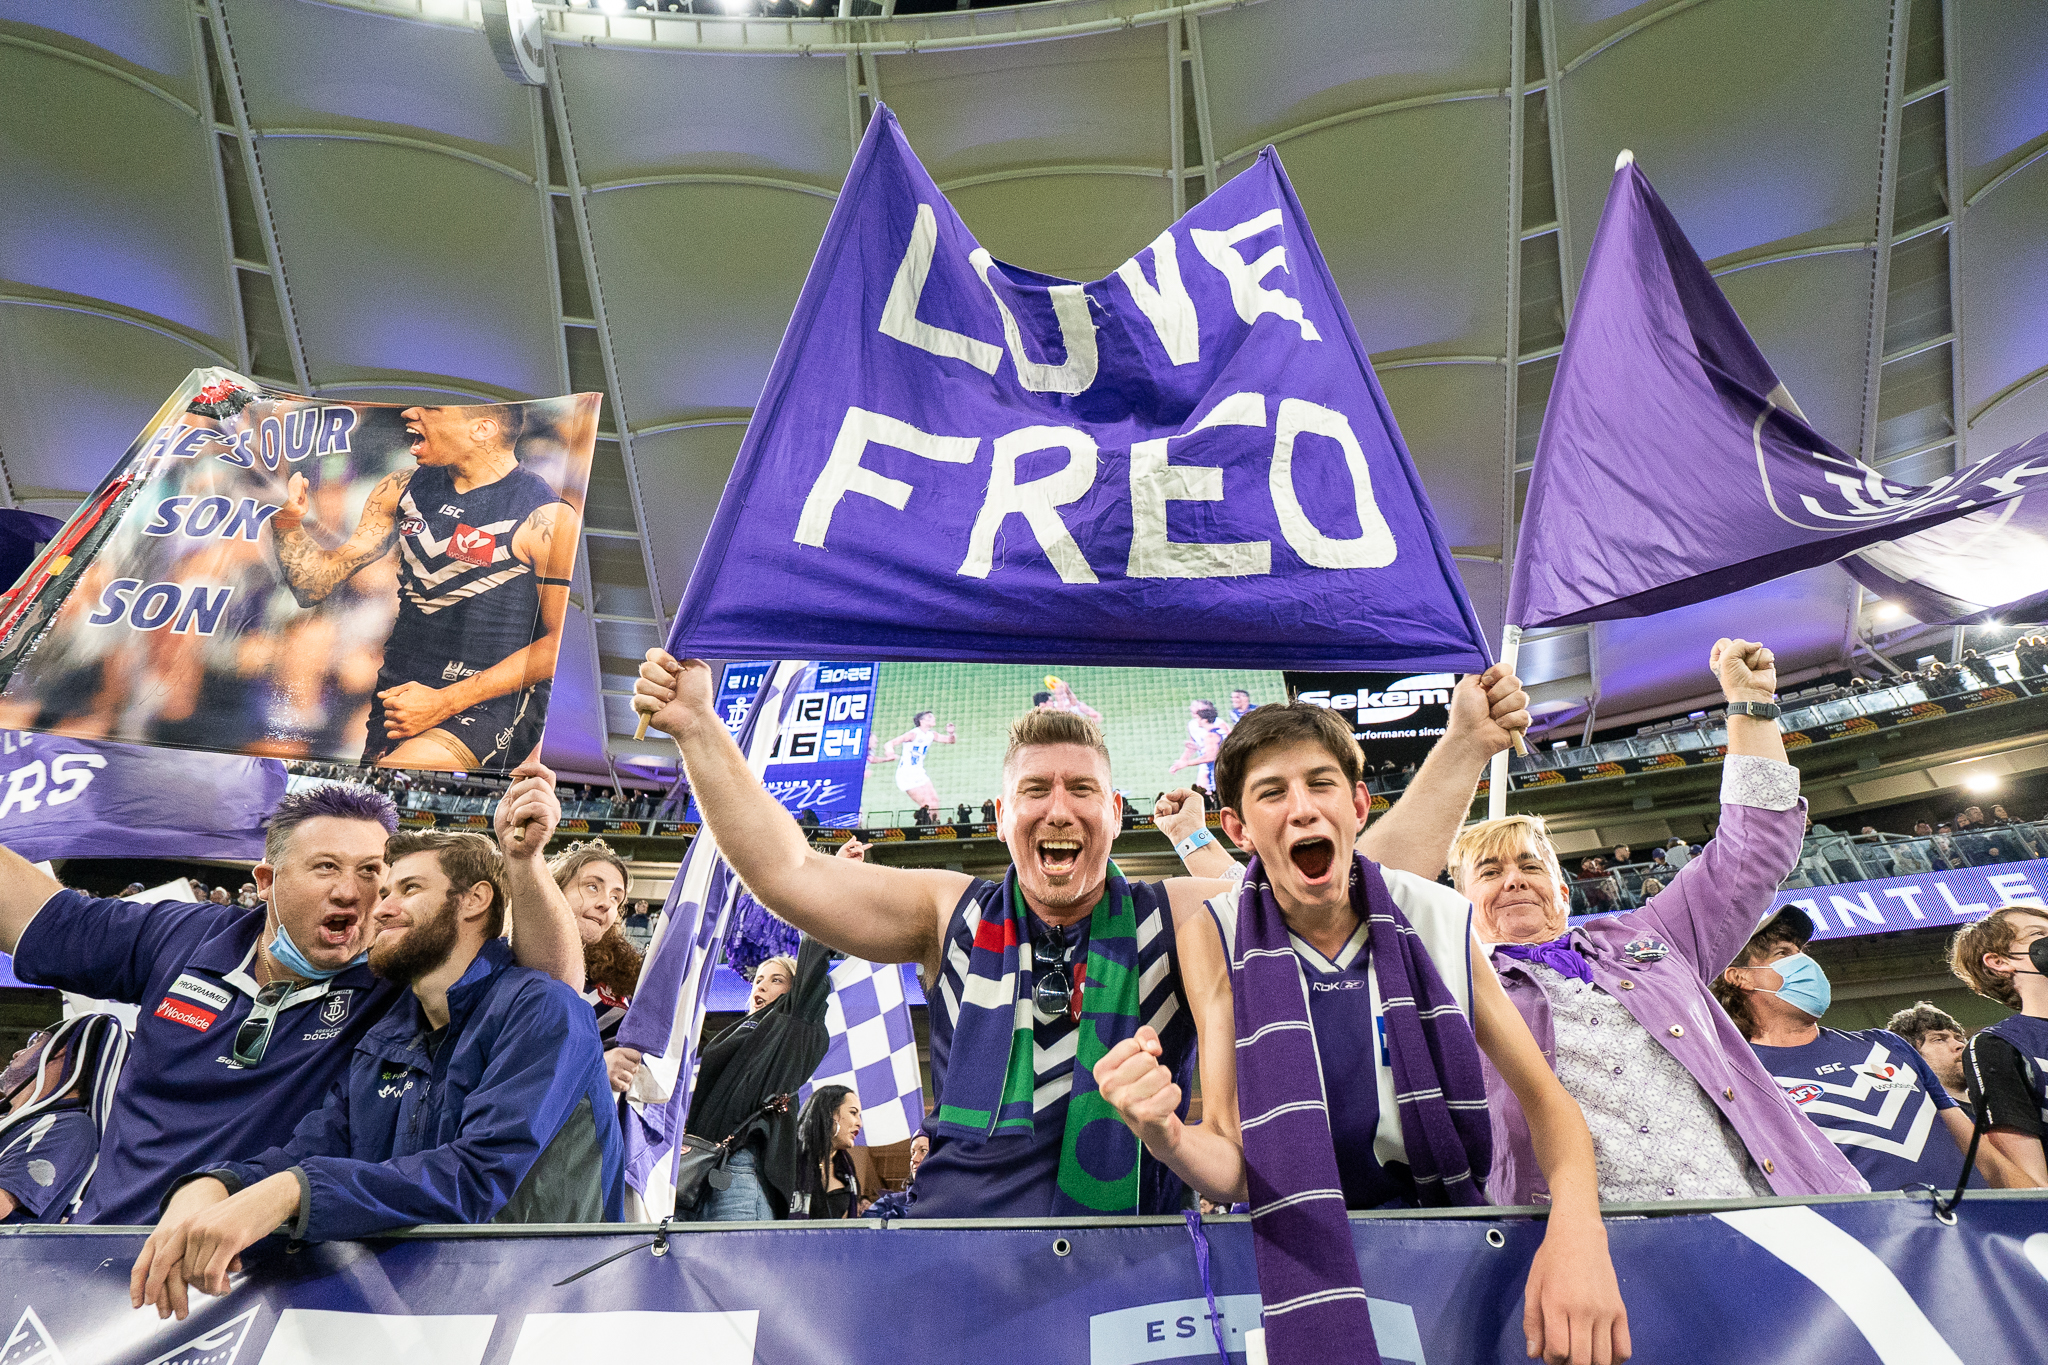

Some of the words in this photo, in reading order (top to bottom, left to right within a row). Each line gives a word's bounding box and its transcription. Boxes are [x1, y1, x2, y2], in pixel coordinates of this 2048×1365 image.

[136, 423, 255, 469] HE'S
[260, 405, 358, 471] OUR
[793, 391, 1398, 585] FREO
[141, 494, 284, 542] SON
[438, 503, 465, 519] ISC
[85, 577, 235, 636] SON
[820, 667, 872, 684] 30:22
[828, 694, 868, 722] 102
[1298, 688, 1449, 710] Sekem
[789, 732, 818, 757] 6
[823, 728, 863, 757] 24
[1418, 726, 1446, 737] since
[177, 979, 229, 1005] PROGRAMMED
[164, 1004, 210, 1031] Woodside
[1815, 1062, 1845, 1076] ISC
[1791, 1086, 1822, 1101] AFL
